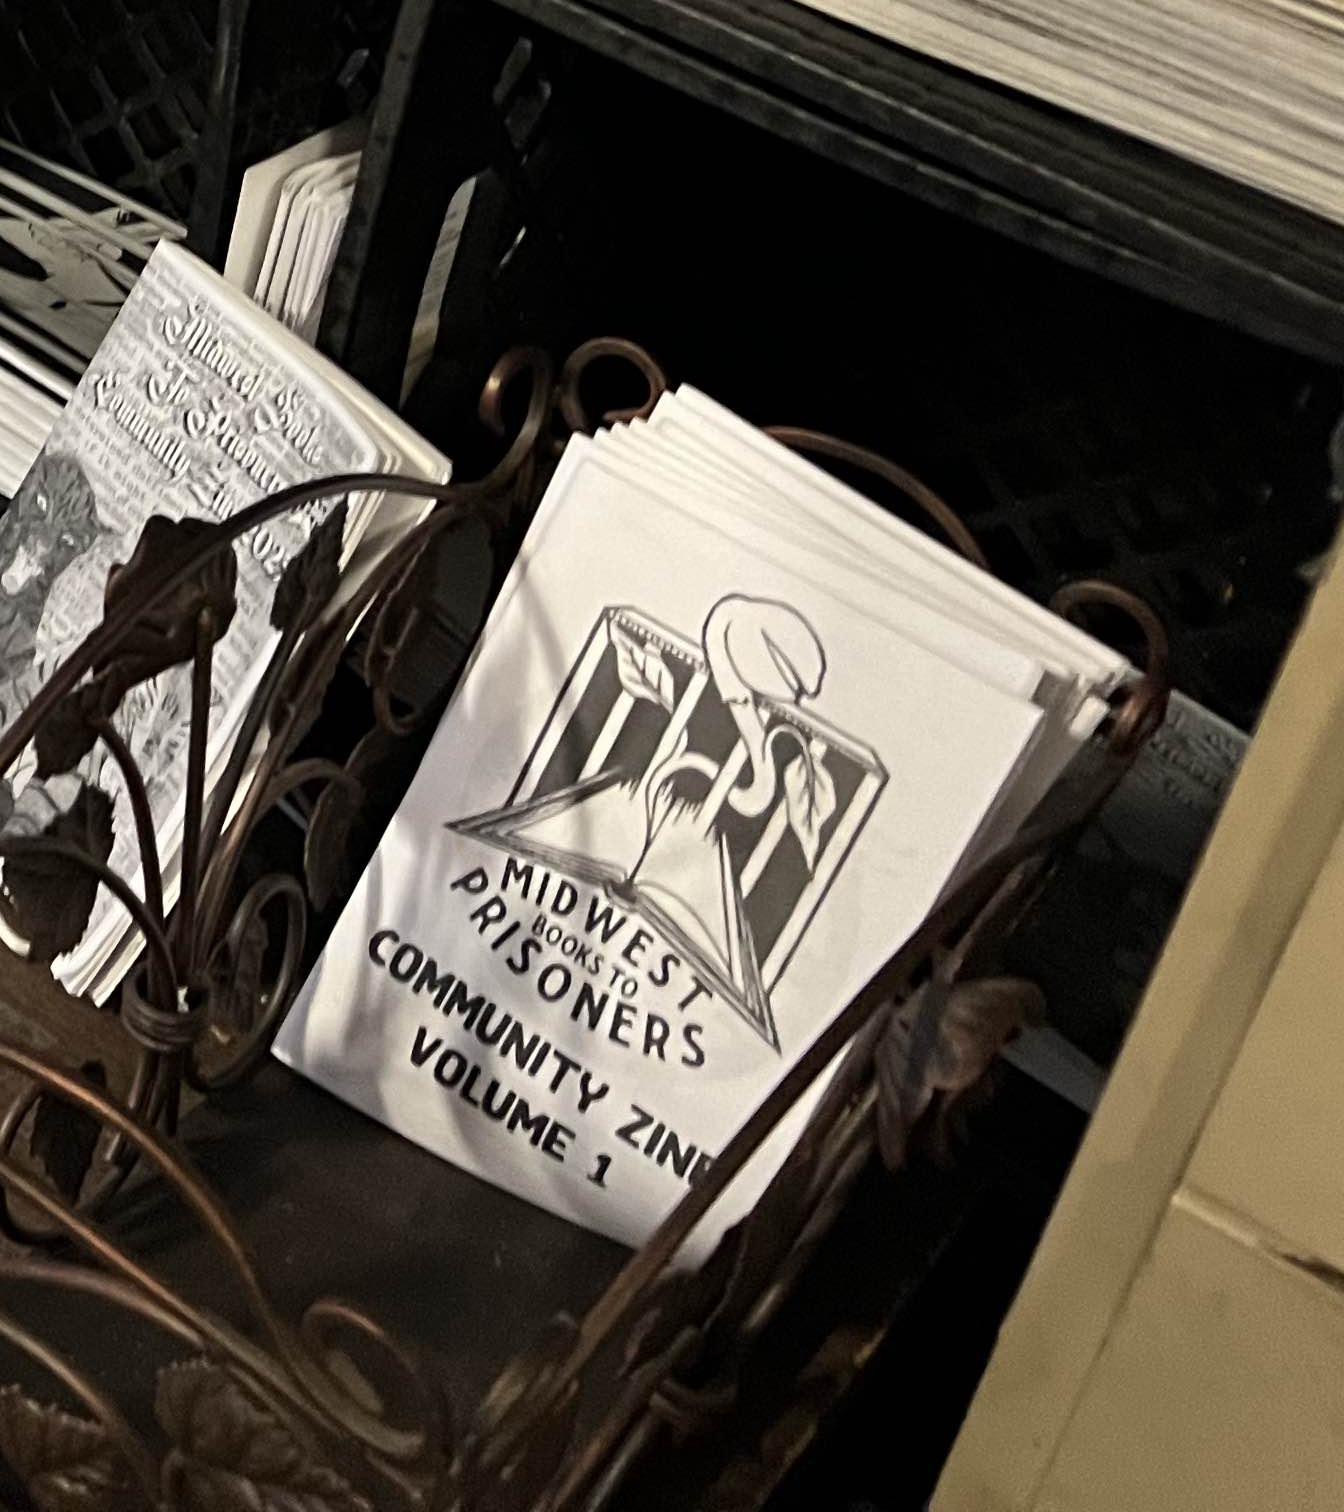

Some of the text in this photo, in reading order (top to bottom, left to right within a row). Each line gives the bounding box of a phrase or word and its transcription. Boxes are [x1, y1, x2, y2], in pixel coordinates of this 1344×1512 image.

[449, 866, 706, 1069] PRISONERS
[500, 855, 714, 1013] MIDWEST
[531, 912, 640, 999] BOOKS TO
[367, 928, 610, 1115] COMMUNITY
[409, 1025, 613, 1189] VOLUME 1
